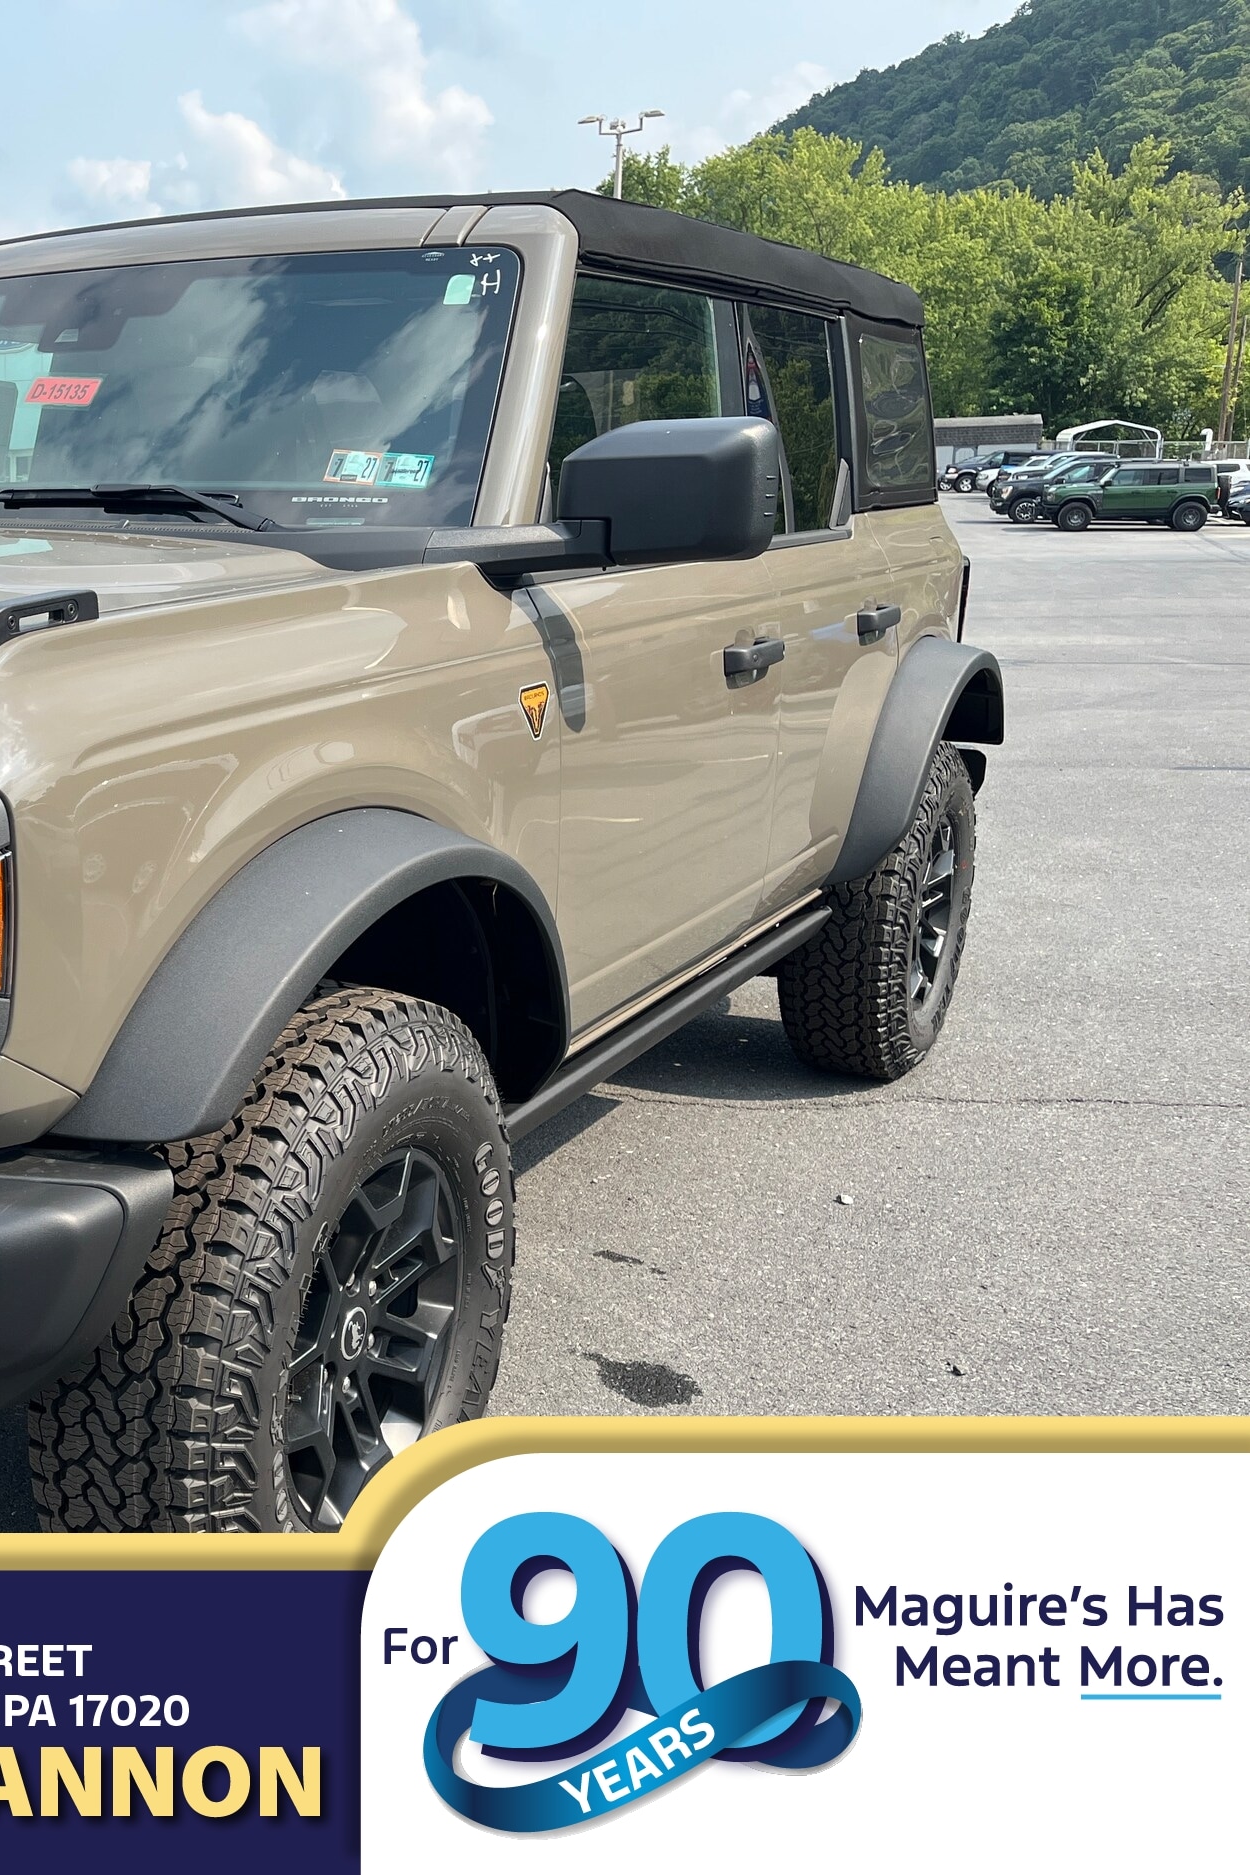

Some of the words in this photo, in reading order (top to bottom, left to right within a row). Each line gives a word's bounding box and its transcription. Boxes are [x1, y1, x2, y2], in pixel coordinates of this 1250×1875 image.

[31, 384, 90, 400] D-15135
[361, 457, 378, 480] 27
[414, 460, 430, 482] 27
